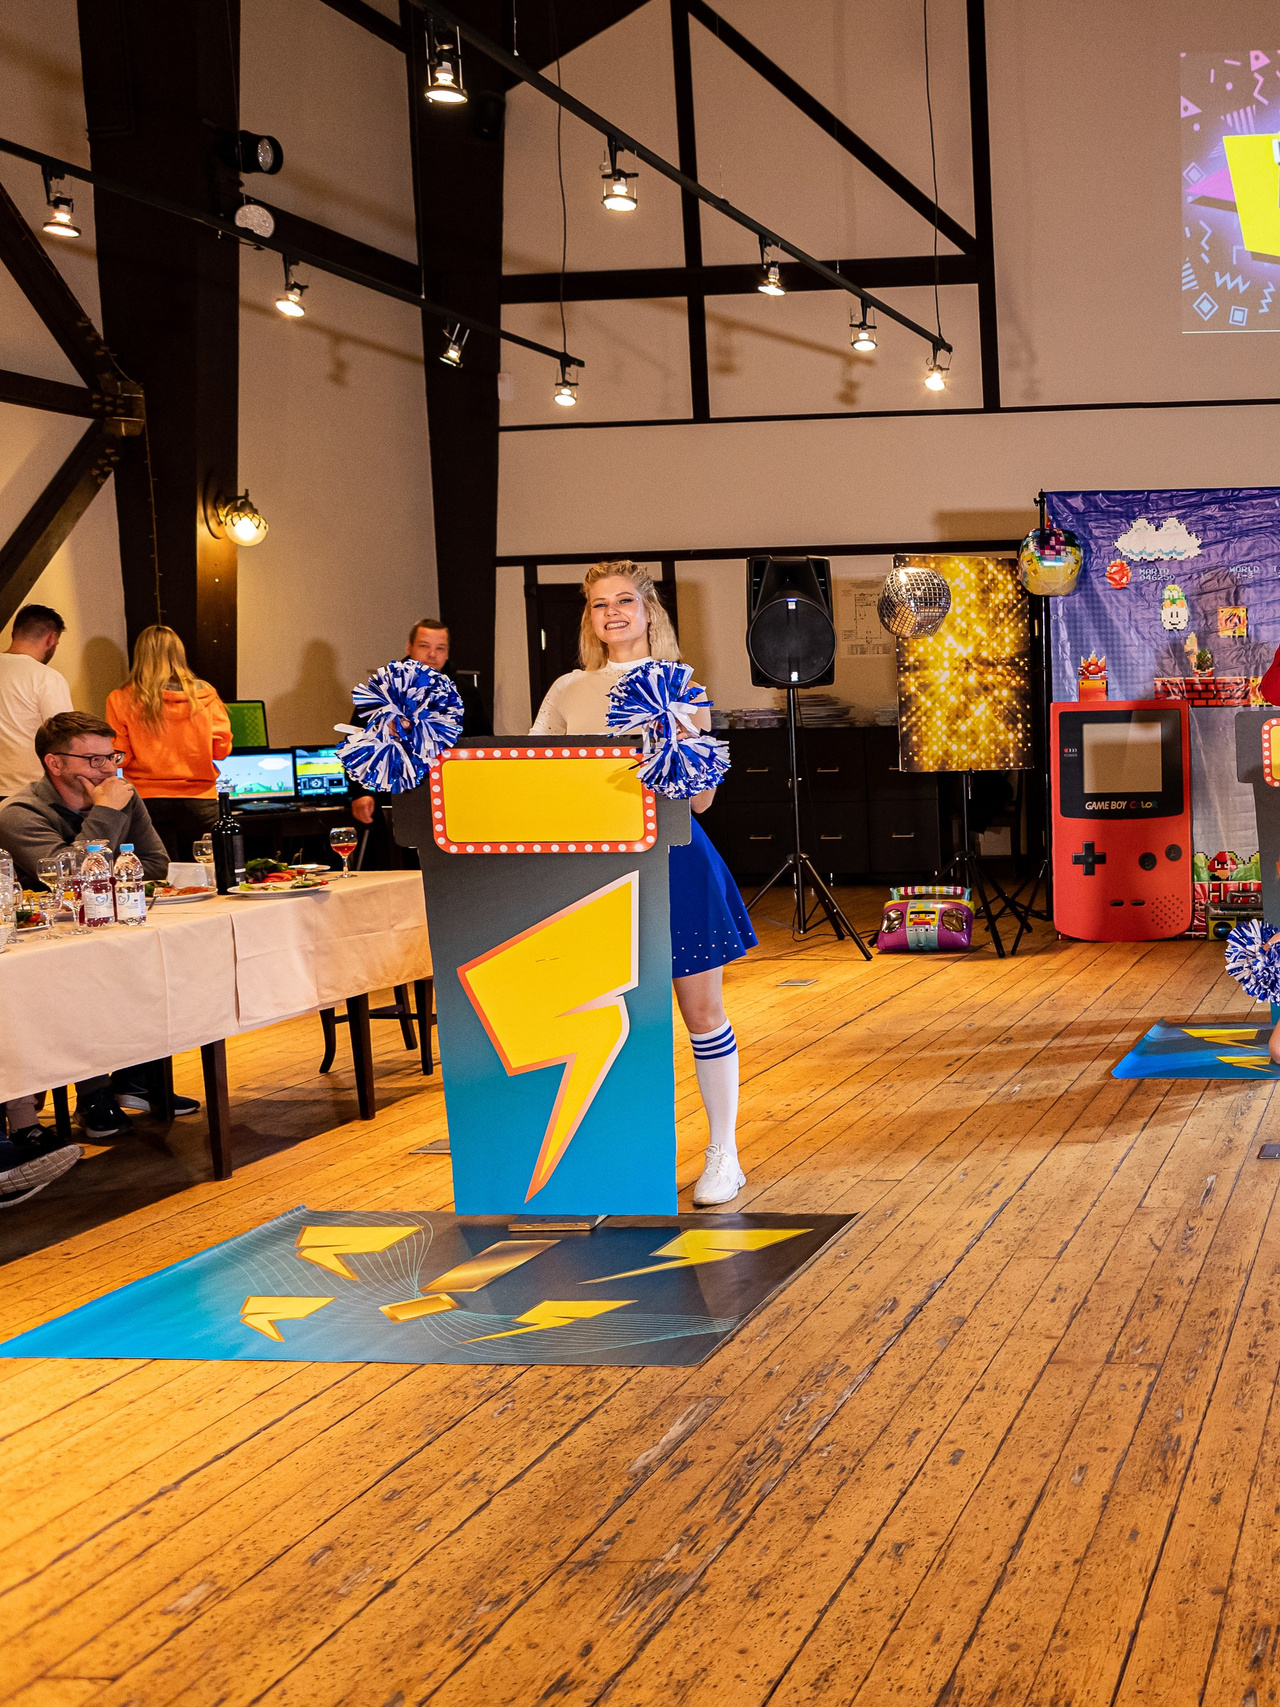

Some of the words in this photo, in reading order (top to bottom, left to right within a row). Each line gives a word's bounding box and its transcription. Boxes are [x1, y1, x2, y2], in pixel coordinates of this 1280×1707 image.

[1272, 138, 1280, 163] I
[1139, 567, 1170, 575] MARIO
[1229, 565, 1260, 573] WORLD
[1085, 801, 1110, 810] GAME
[1110, 800, 1128, 810] BOY
[1129, 800, 1158, 809] CLOR
